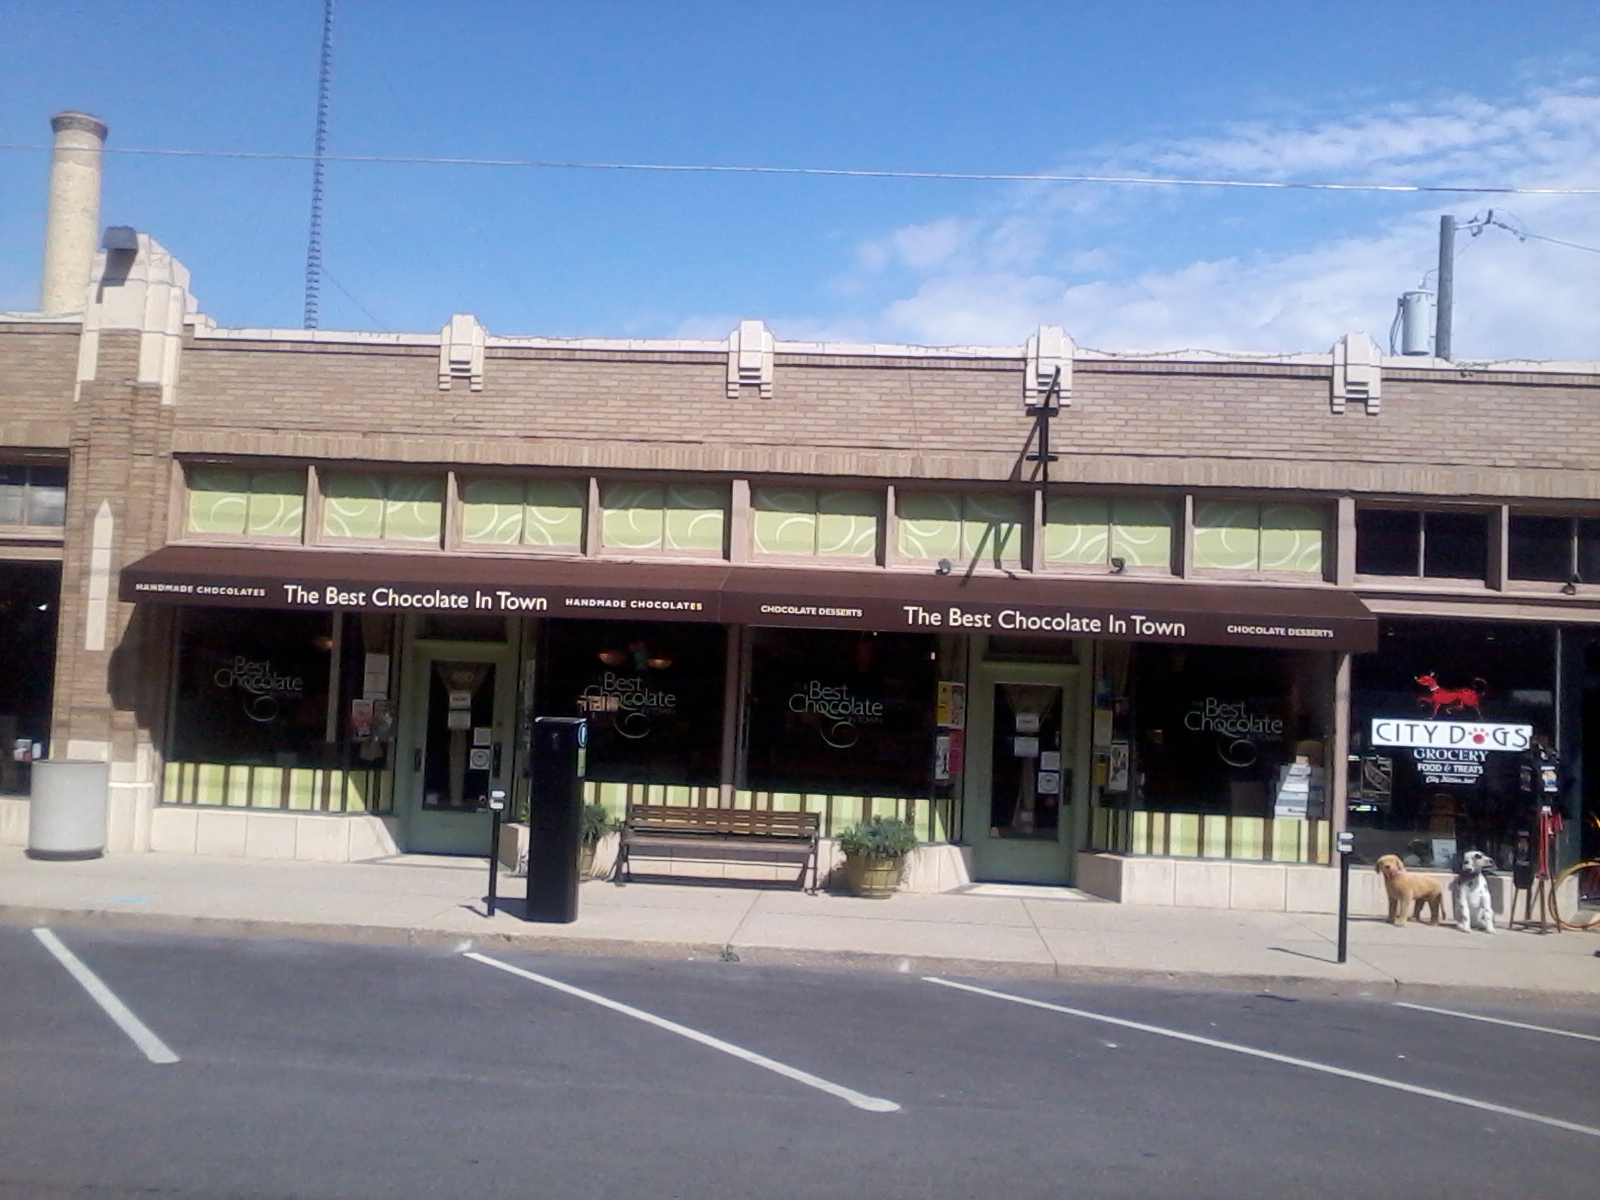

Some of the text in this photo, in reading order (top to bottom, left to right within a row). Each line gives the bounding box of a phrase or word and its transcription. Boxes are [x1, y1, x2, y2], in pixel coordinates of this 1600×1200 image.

[135, 583, 266, 597] HANDMADE CHOCOLATES
[283, 584, 548, 611] The Best Chocolate In Town
[565, 597, 703, 611] HANDMADE CHOCOLATES
[760, 605, 863, 617] CHOCOLATE DESSERTS
[903, 606, 1186, 637] The Best Chocolate In Town
[1227, 625, 1334, 638] CHOCOLATE DESSERTS
[234, 655, 271, 674] Best
[214, 669, 303, 692] Chocolate
[604, 671, 643, 691] Best
[809, 680, 849, 700] Best
[583, 685, 676, 709] Chocolate
[788, 693, 883, 718] Chocolate
[1205, 697, 1247, 718] Best
[1184, 711, 1283, 735] Chocolate
[1376, 722, 1438, 744] CITY
[1413, 749, 1489, 762] GROCERY
[1417, 763, 1442, 773] FOOD
[1453, 765, 1484, 774] TREATS
